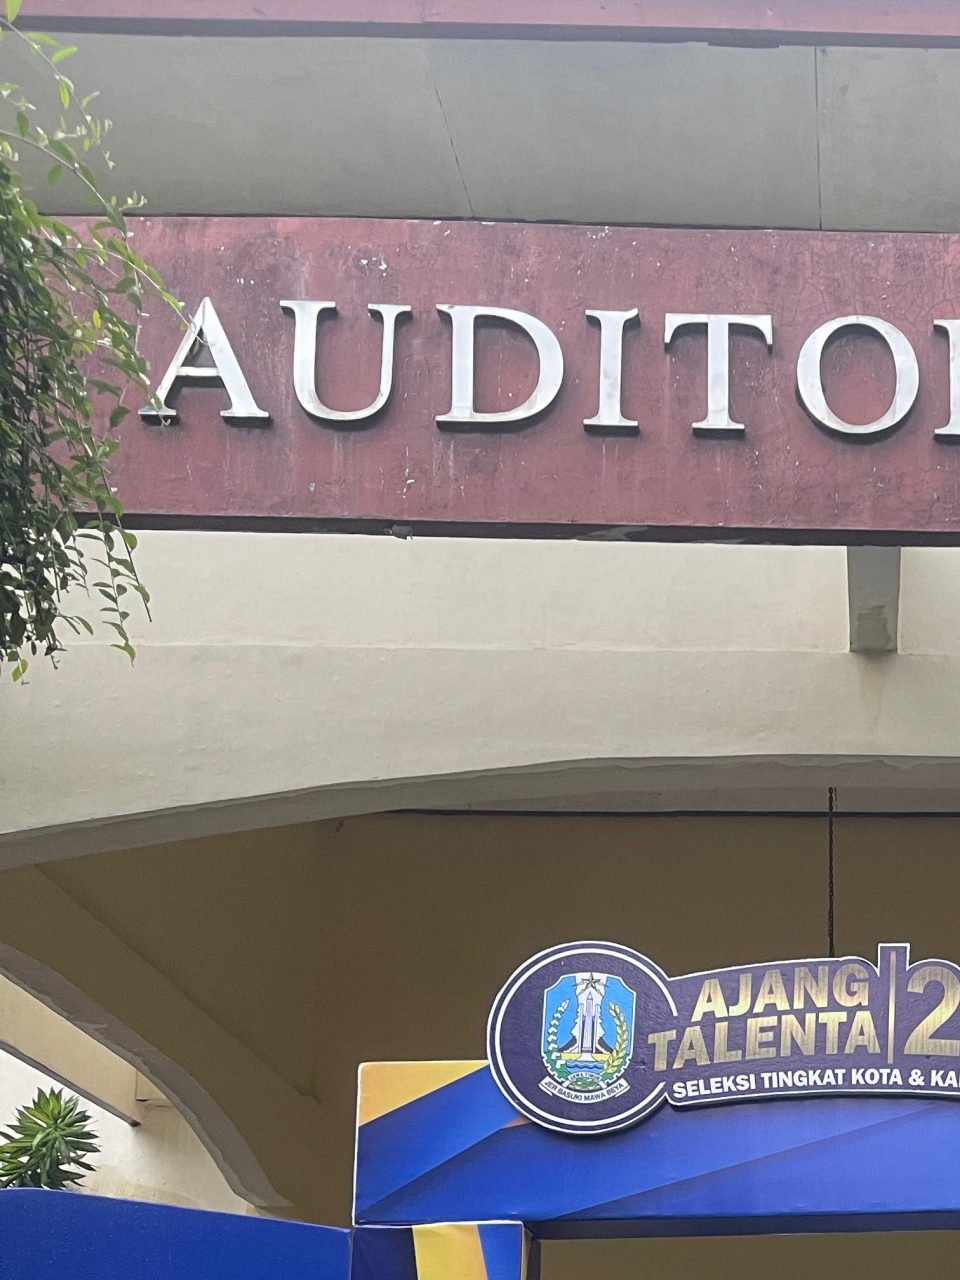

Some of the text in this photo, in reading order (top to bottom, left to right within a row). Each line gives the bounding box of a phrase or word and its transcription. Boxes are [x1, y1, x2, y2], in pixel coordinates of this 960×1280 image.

[691, 963, 869, 1022] AJANG
[648, 1011, 881, 1072] TALENTA
[544, 1081, 625, 1101] JER BASUKI MAWA BEYA
[672, 1074, 756, 1098] SELEKSI
[761, 1069, 846, 1088] TINGKAT
[852, 1068, 902, 1085] KOTA
[908, 1069, 925, 1086] &
